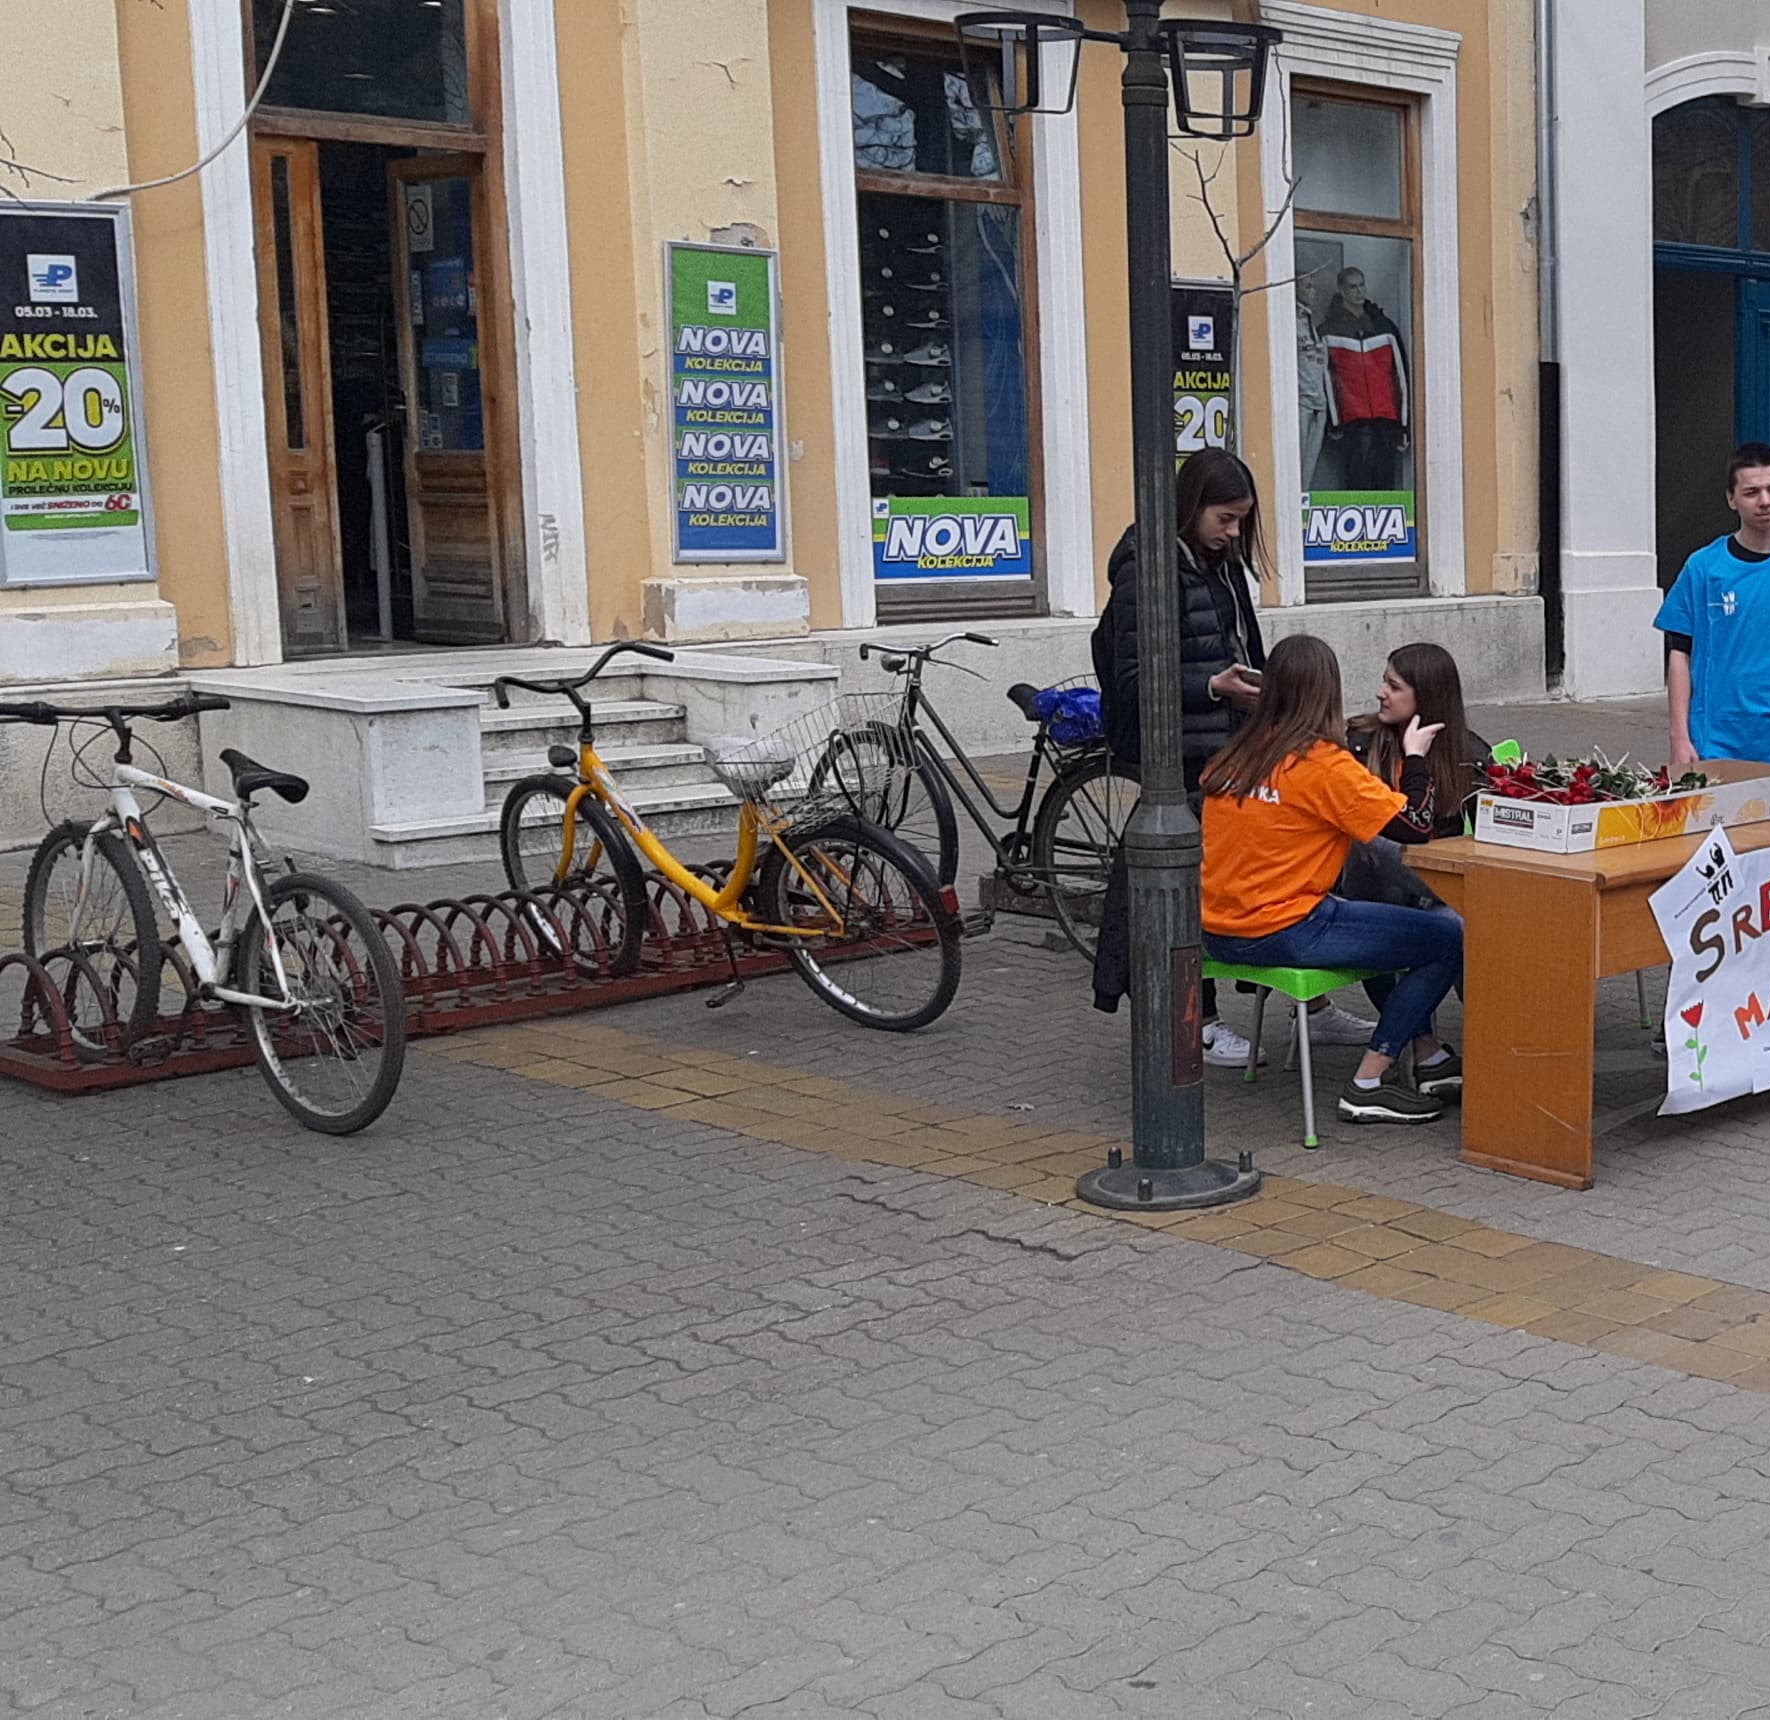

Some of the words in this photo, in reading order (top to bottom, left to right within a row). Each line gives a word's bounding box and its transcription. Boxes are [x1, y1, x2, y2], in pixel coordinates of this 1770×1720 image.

[0, 333, 119, 359] AKCIJA
[678, 326, 768, 357] NOVA
[684, 356, 764, 374] KOLEKCIJA
[1173, 370, 1232, 390] AKCIJA
[679, 379, 769, 410] NOVA
[686, 408, 765, 425] KOLEKCIJA
[680, 432, 771, 462] NOVA
[8, 461, 49, 482] NA
[53, 458, 129, 481] NOVU
[687, 461, 767, 476] KOLEKCIJA
[72, 481, 133, 494] KOLEKCIJU
[682, 484, 773, 512] NOVA
[688, 512, 768, 528] KOLEKCIJA
[1305, 506, 1407, 545] NOVA
[885, 515, 1020, 559] NOVA
[917, 555, 994, 569] KOLEKCIJA
[1495, 807, 1533, 823] MISTRAL
